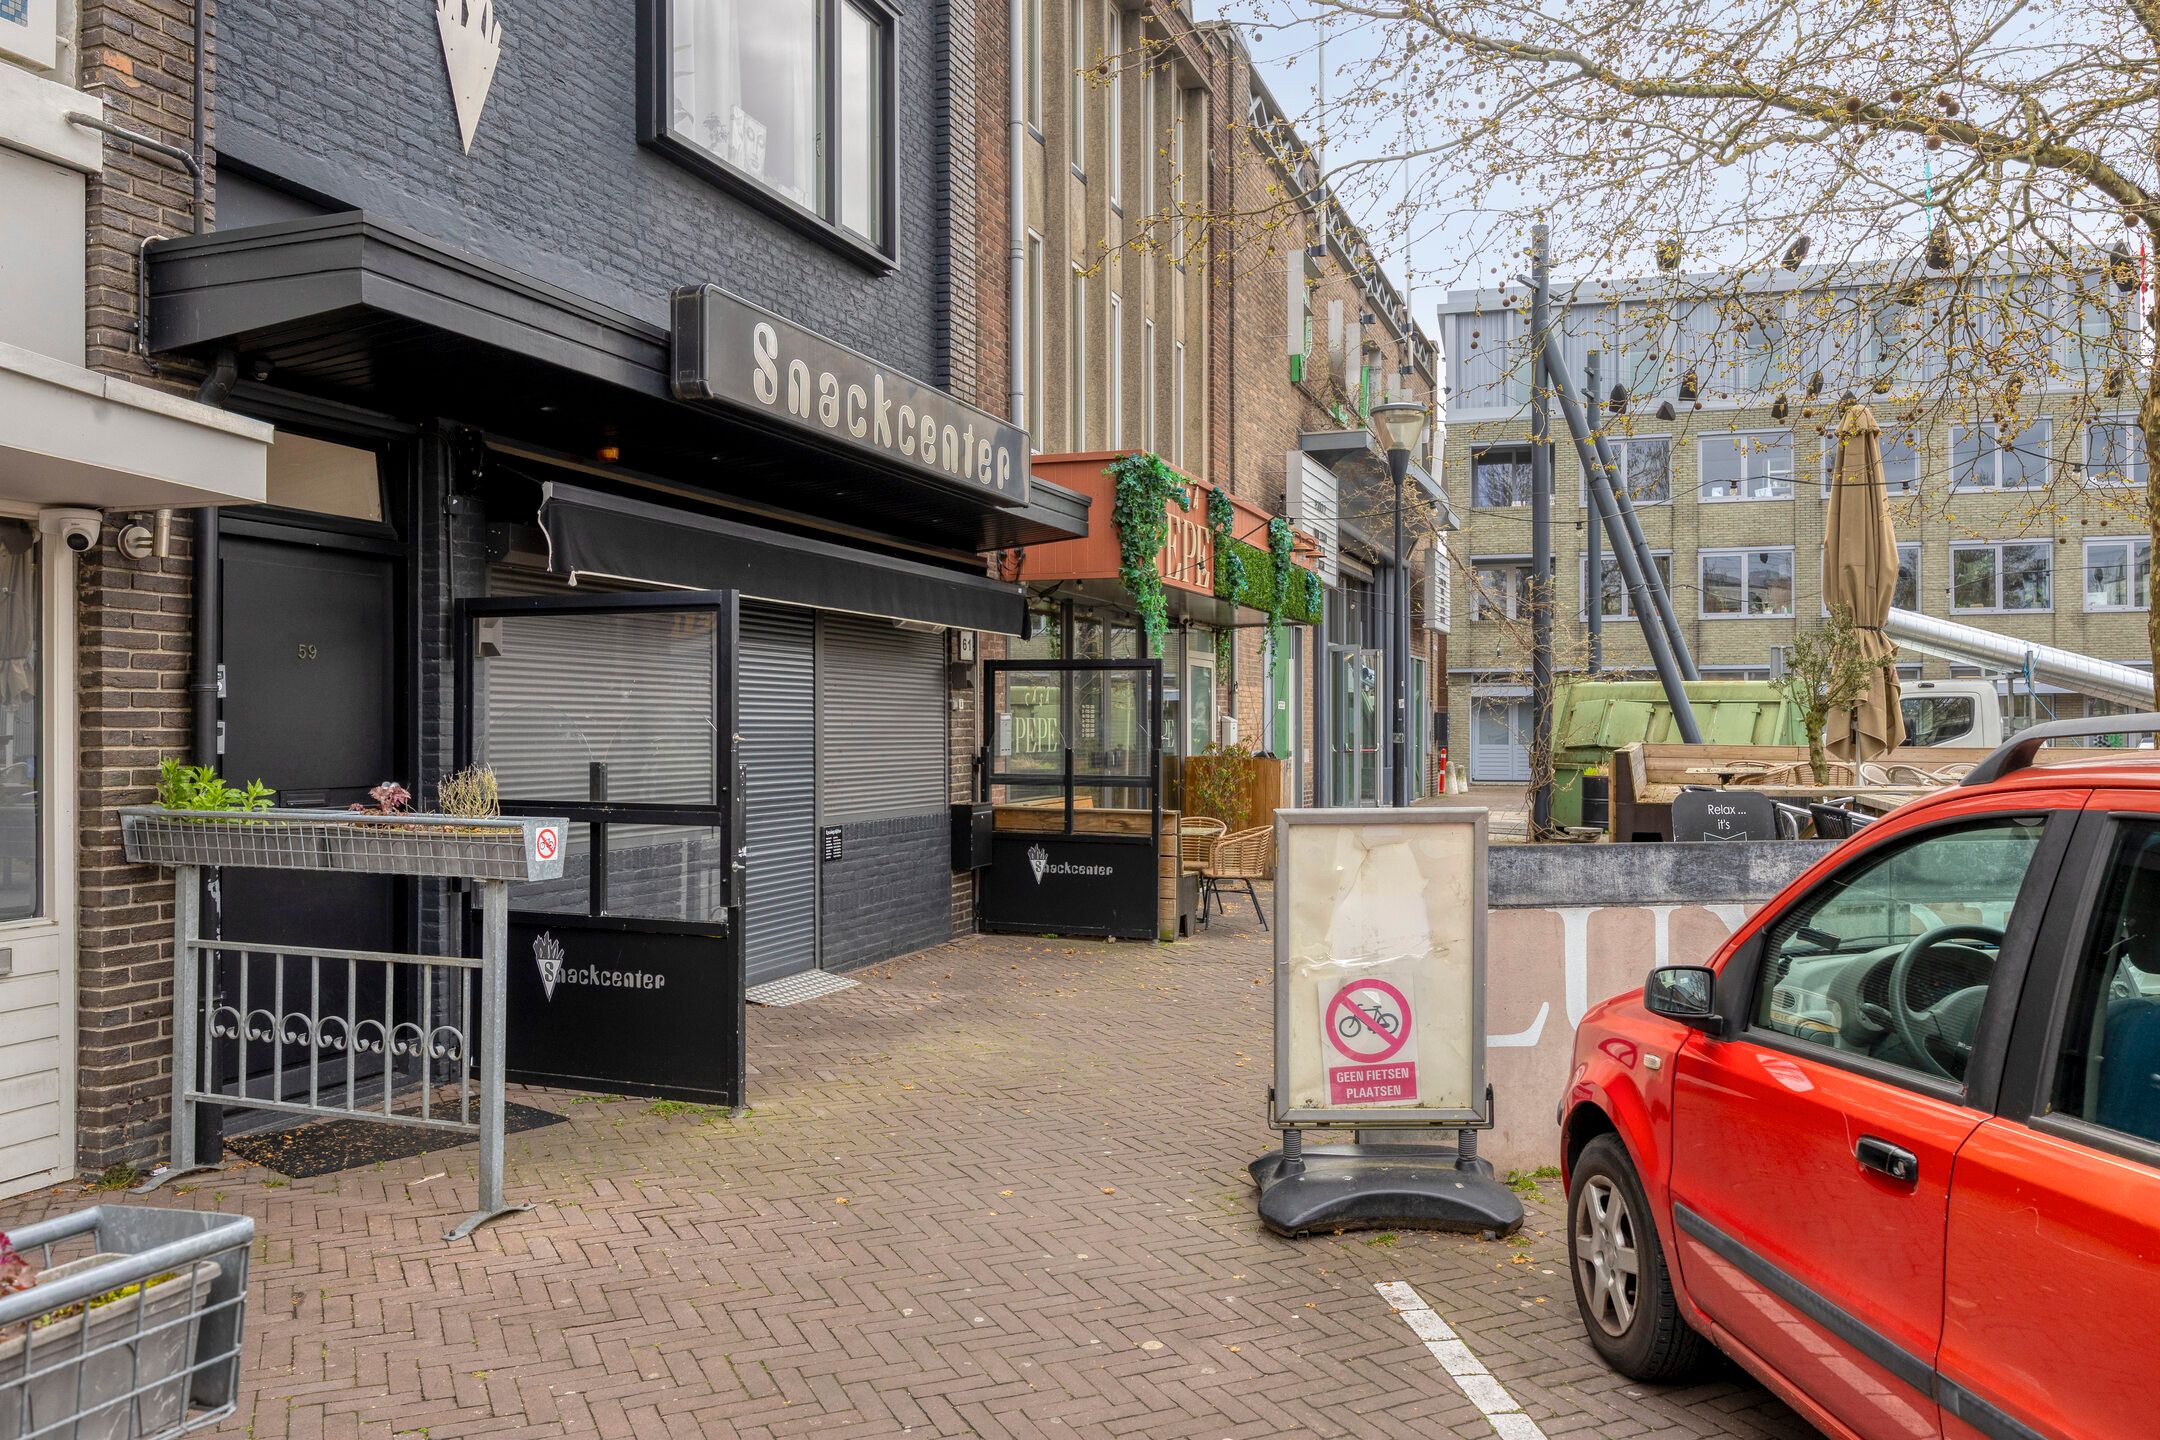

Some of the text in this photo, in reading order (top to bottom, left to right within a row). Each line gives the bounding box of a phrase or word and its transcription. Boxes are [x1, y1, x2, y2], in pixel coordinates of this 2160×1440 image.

[753, 322, 1010, 490] Snackcenter
[1162, 512, 1212, 589] EPE
[297, 643, 317, 660] 59
[962, 638, 972, 651] 61
[1015, 717, 1058, 753] PEPE
[1707, 804, 1737, 815] Relax
[1717, 818, 1731, 830] it's
[544, 961, 666, 990] Snackcenter
[1336, 1067, 1409, 1083] GEEN FIETSEN
[1346, 1084, 1401, 1099] PLAATSEN
